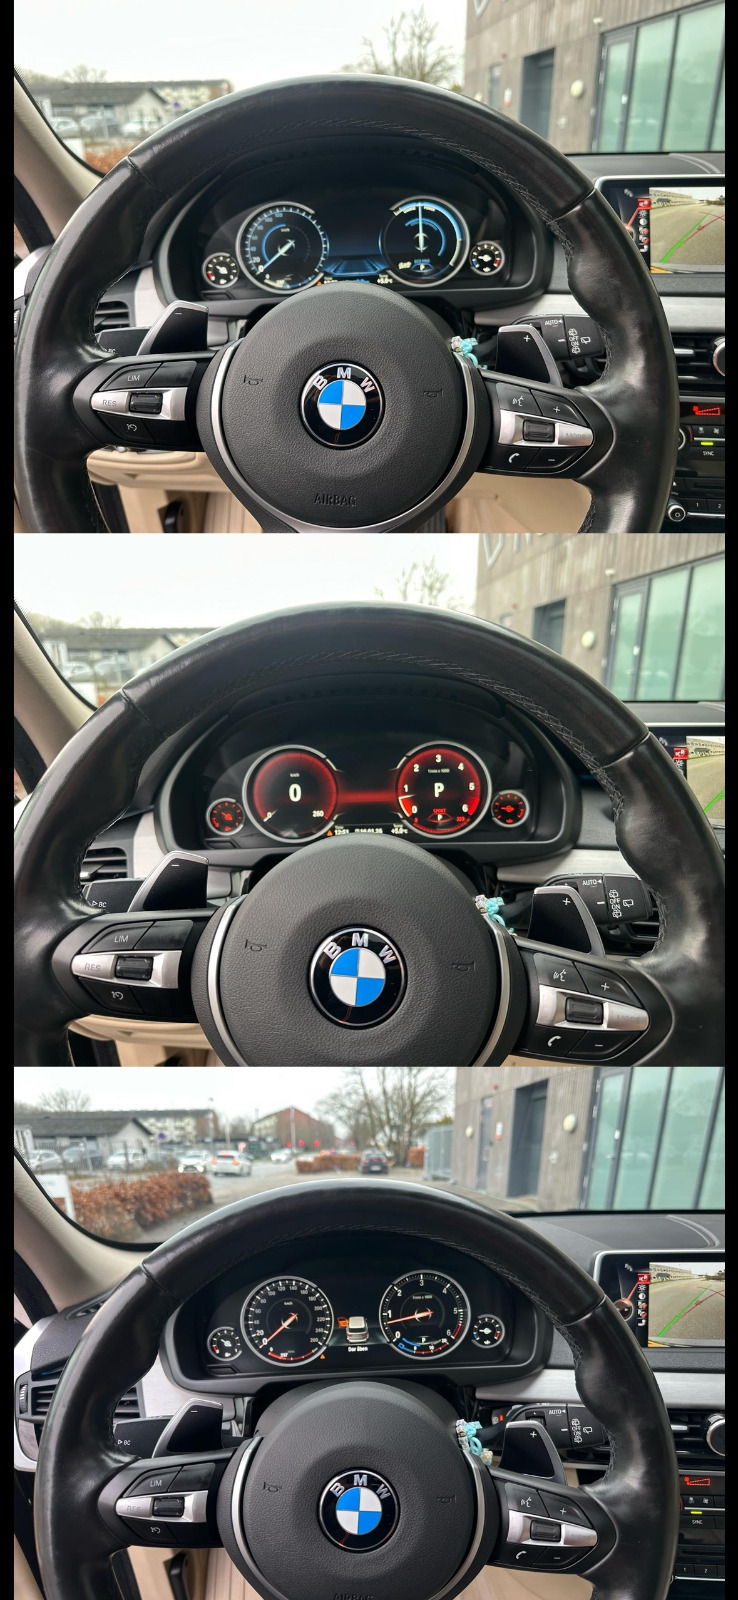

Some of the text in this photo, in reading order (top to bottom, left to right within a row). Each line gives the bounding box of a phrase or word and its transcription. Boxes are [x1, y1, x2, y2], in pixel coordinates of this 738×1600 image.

[258, 264, 264, 273] 0
[127, 374, 141, 382] LIM
[313, 367, 376, 393] BMW
[102, 399, 117, 407] RES
[313, 493, 357, 507] AIRBAG
[435, 753, 442, 763] 3
[413, 763, 420, 772] 2
[457, 762, 465, 771] 4
[403, 784, 409, 793] 1
[434, 782, 445, 798] P
[468, 782, 475, 791] 5
[289, 783, 302, 802] 0
[411, 805, 418, 814] 0
[462, 804, 469, 813] 6
[266, 811, 272, 819] 0
[114, 935, 129, 943] LIM
[324, 932, 397, 964] BMW
[84, 963, 102, 972] RES
[397, 1289, 402, 1297] 2
[387, 1309, 392, 1318] 1
[453, 1307, 458, 1315] 5
[395, 1331, 401, 1339] 0
[446, 1329, 451, 1337] 6
[262, 1337, 268, 1346] 0
[330, 1474, 391, 1500] BMW
